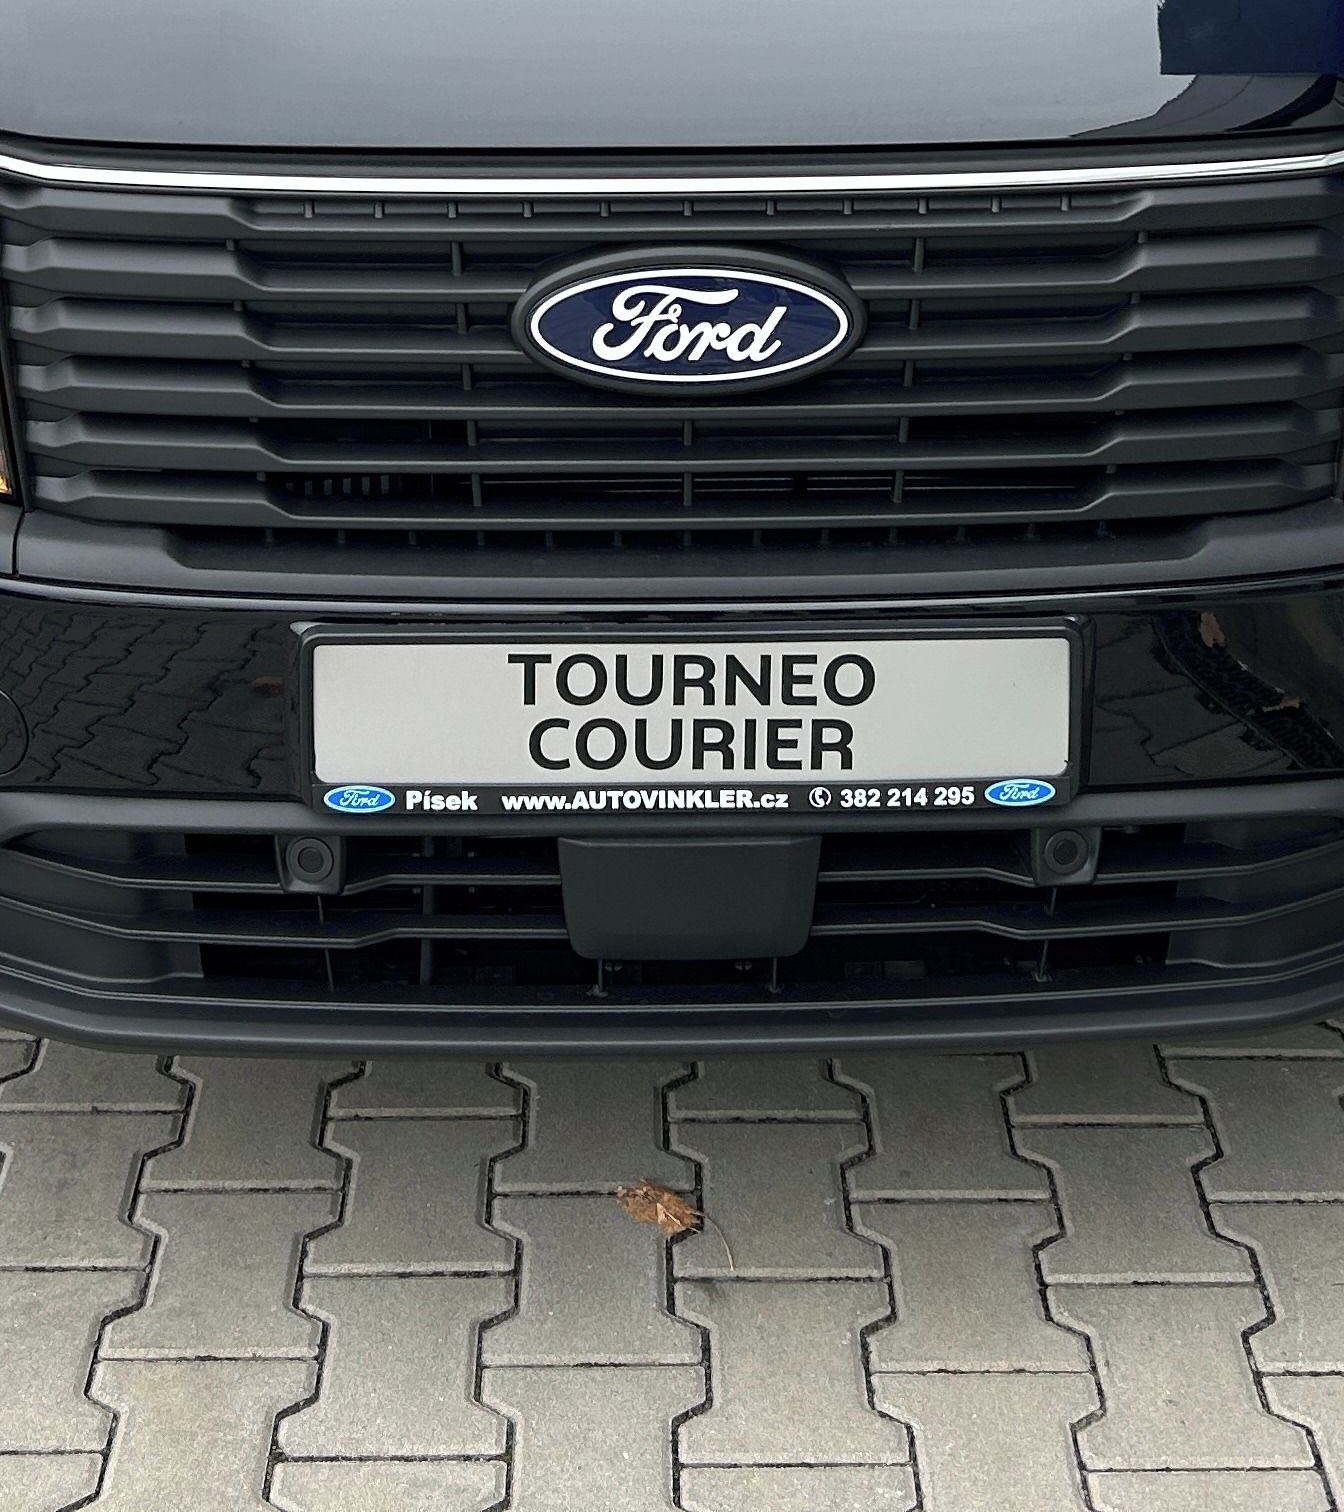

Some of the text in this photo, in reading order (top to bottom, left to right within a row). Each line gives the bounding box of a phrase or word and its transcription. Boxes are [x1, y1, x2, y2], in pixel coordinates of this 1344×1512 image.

[592, 284, 788, 362] Ford
[507, 653, 876, 706] TOURNEO
[528, 717, 854, 770] COURIER
[338, 783, 1040, 811] Ford Písek www.AUTOVINKLER.cz 382 214 295 Ford
